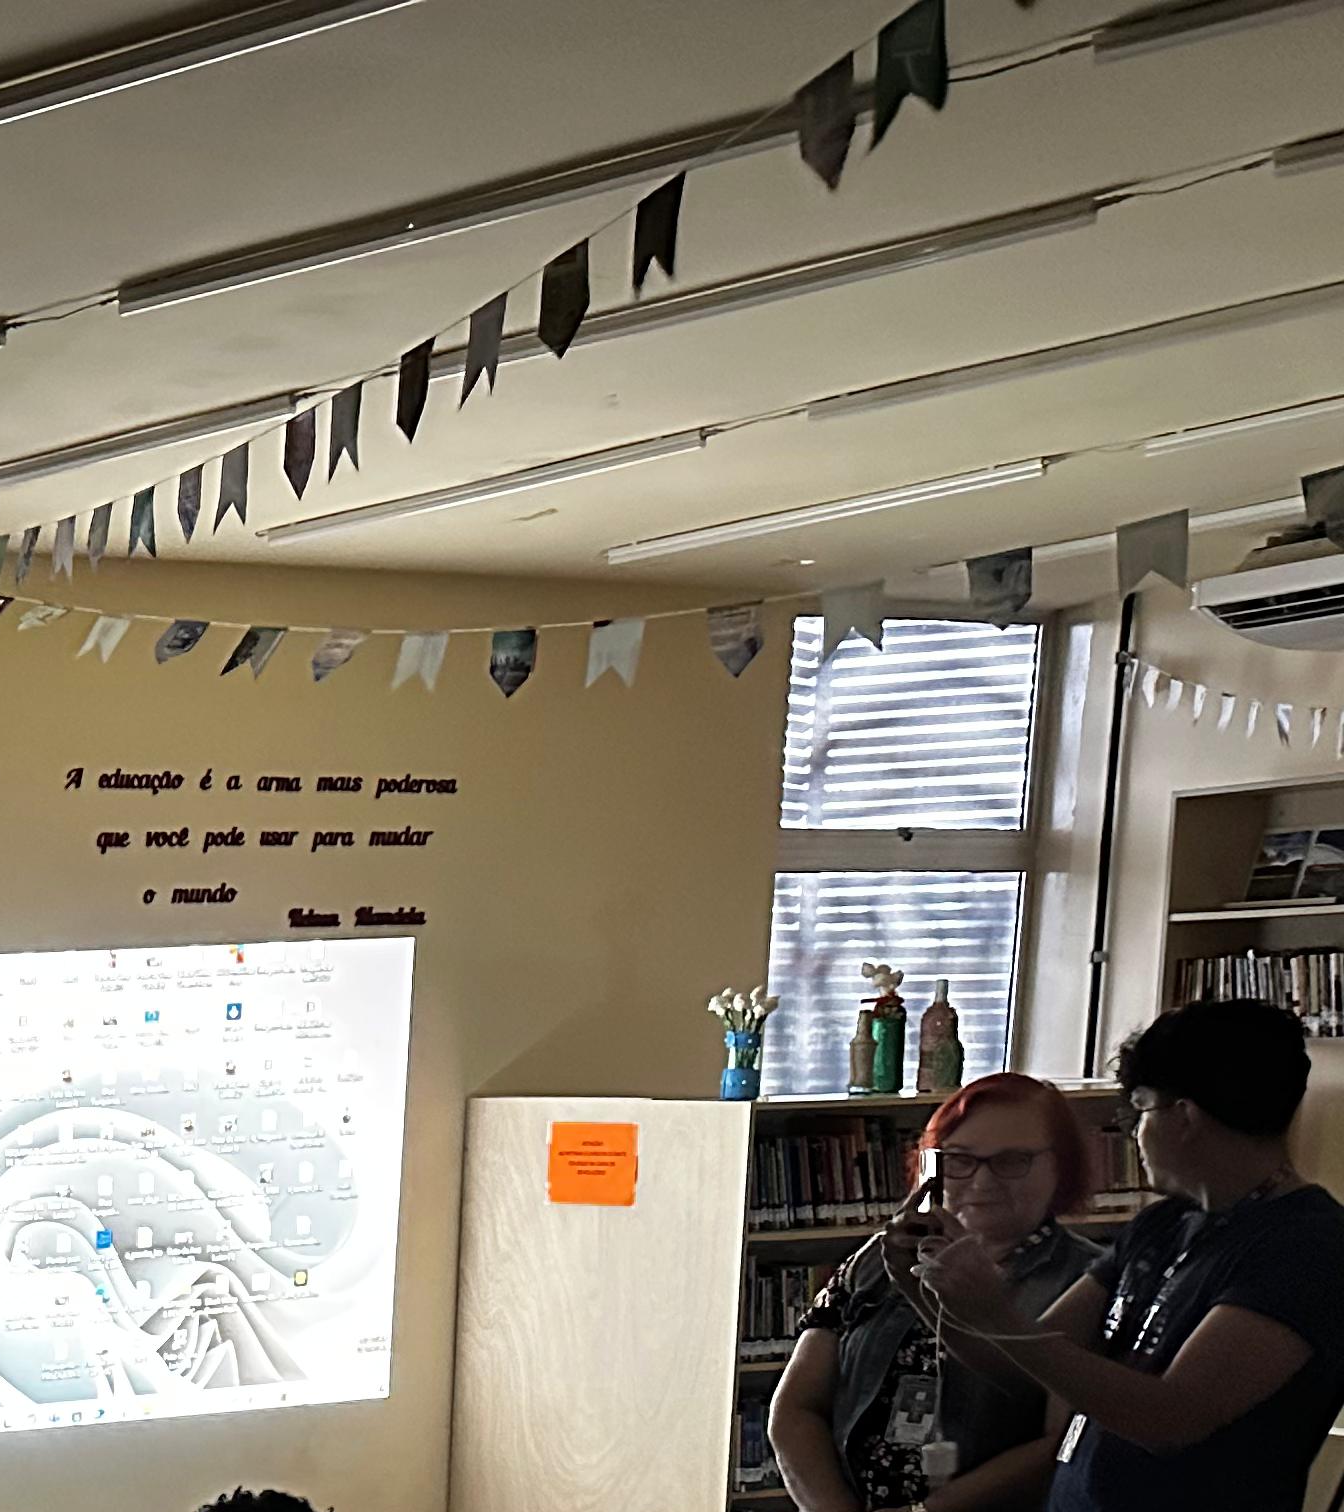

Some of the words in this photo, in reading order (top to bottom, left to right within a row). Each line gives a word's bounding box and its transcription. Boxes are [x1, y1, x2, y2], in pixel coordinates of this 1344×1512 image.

[64, 767, 85, 791] A
[98, 767, 184, 797] educação
[199, 768, 213, 791] é
[226, 773, 242, 791] a
[256, 775, 302, 793] arma
[316, 776, 363, 793] mais
[375, 773, 458, 800] poderosa
[96, 829, 130, 855] que
[145, 825, 189, 848] você
[202, 827, 246, 853] pode
[259, 829, 299, 848] usar
[311, 830, 354, 853] para
[368, 826, 434, 847] mudar
[143, 888, 157, 904] o
[171, 883, 238, 904] mundo
